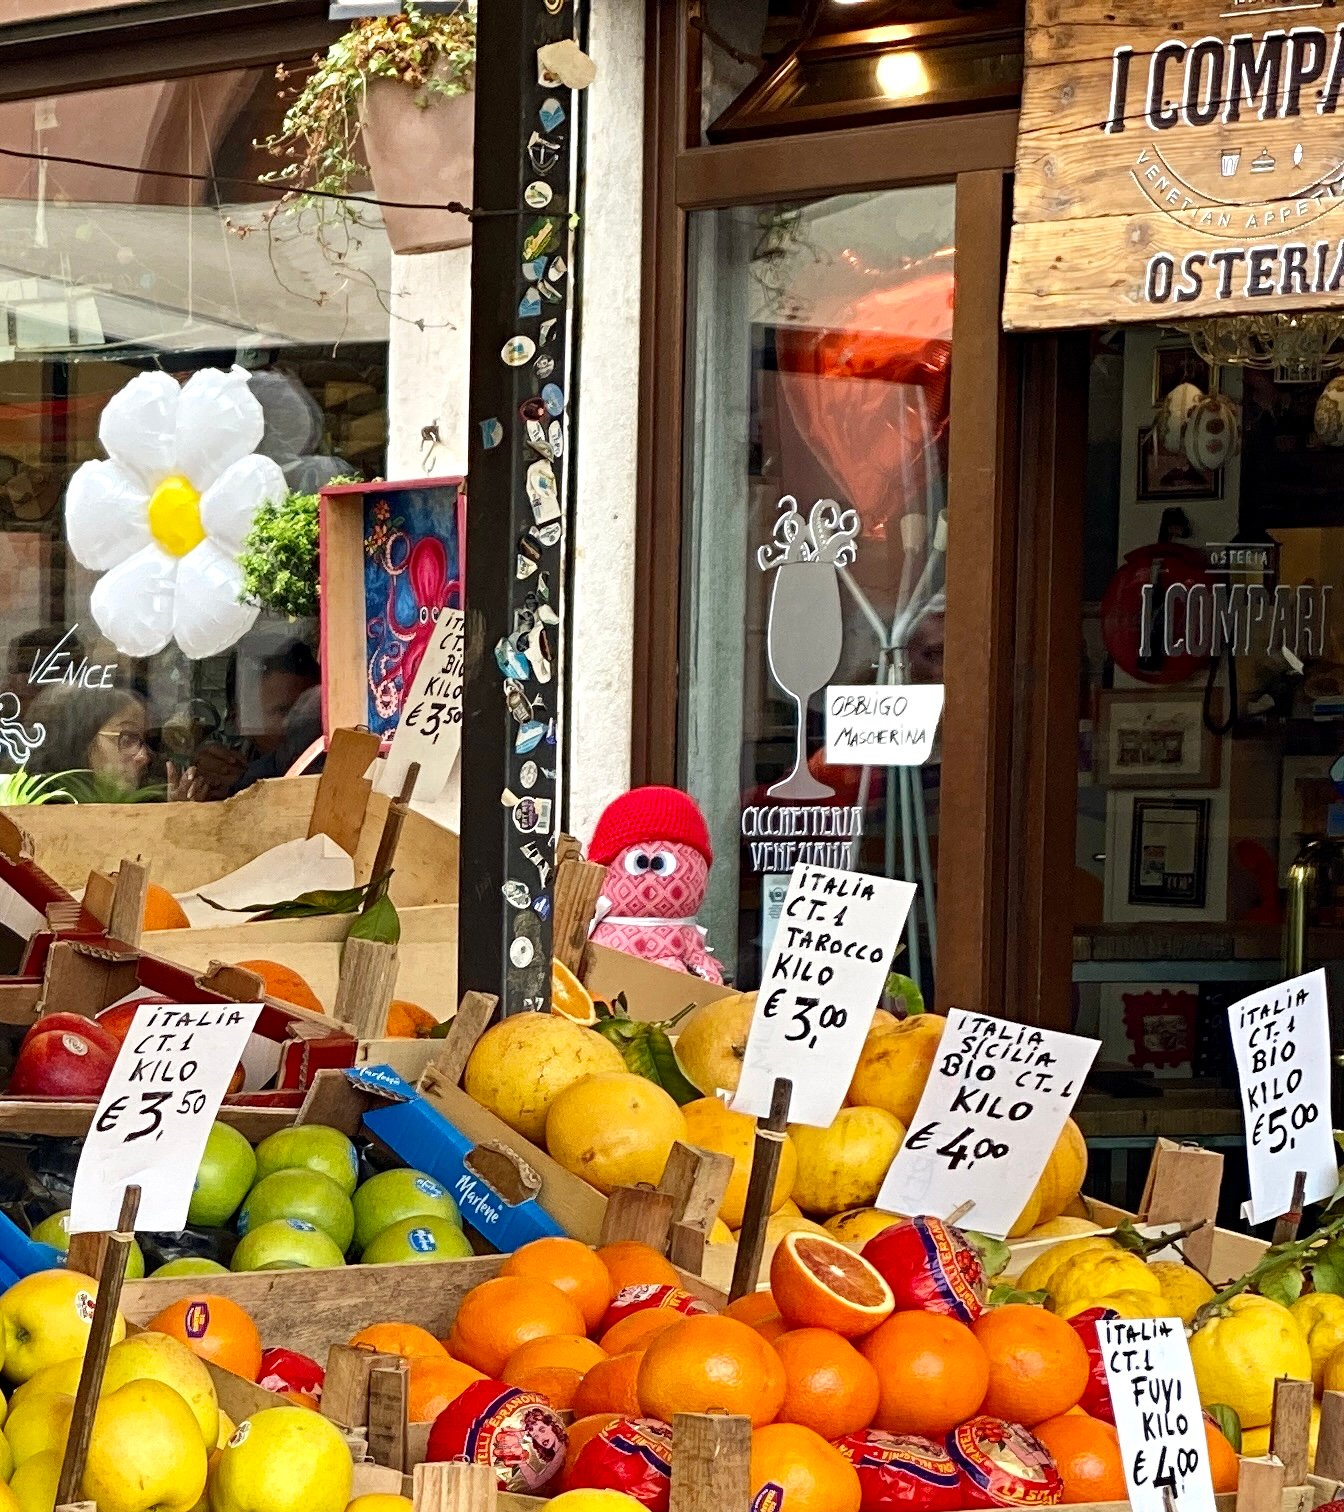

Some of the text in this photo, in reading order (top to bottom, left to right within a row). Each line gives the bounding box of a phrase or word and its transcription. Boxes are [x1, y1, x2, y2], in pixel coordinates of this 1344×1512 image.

[1104, 45, 1133, 135] I
[1135, 150, 1232, 228] VENETIAN
[1211, 550, 1269, 565] OSTERIA
[1139, 583, 1333, 658] I COMPARI
[28, 623, 119, 689] VENICE
[423, 677, 463, 700] KILO
[831, 695, 909, 718] OBBLIGO
[742, 806, 864, 836] CICCHETTERIA
[751, 842, 854, 872] VENEZIANA
[787, 926, 884, 963] TAROCCO
[772, 952, 835, 986] KILO
[958, 1016, 1045, 1046] ITALIA
[940, 1053, 996, 1082] BIO
[961, 1036, 1058, 1068] SICILIA
[1252, 1039, 1296, 1074] BIO
[128, 1058, 198, 1083] KILO
[949, 1085, 1034, 1121] KILO
[1247, 1069, 1303, 1113] KILO
[455, 1175, 500, 1224] Marlene
[1131, 1376, 1183, 1415] FUYI
[1143, 1412, 1189, 1442] KILO
